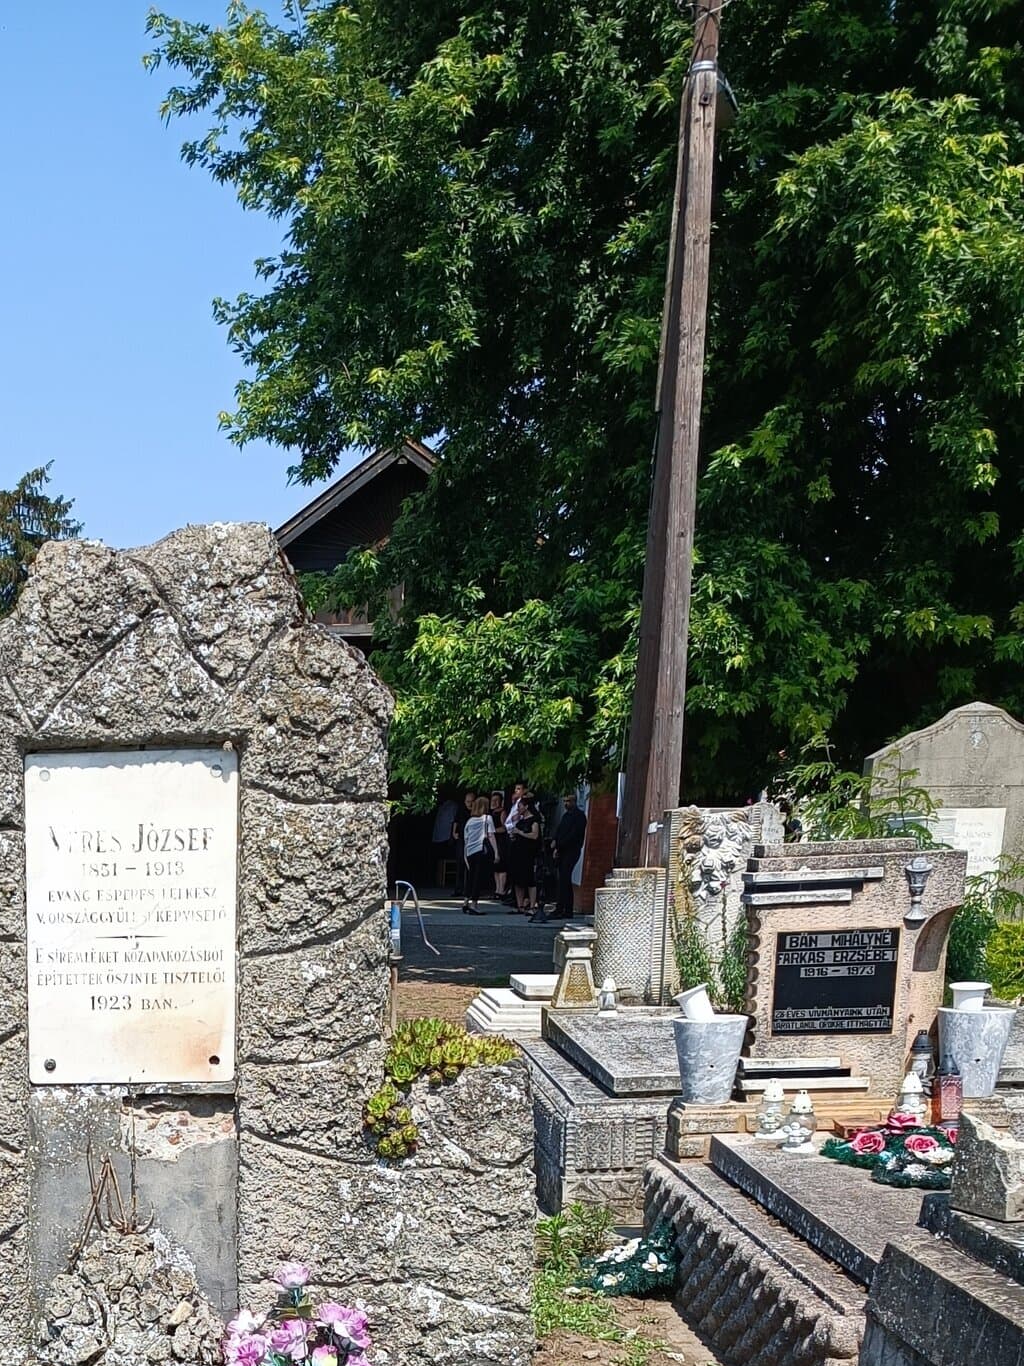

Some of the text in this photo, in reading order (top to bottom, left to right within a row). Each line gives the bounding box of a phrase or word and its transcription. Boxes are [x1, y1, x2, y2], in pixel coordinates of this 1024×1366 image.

[132, 822, 215, 853] JÓZSEF
[778, 951, 826, 964] FARKAS
[804, 967, 828, 976] 1916
[847, 966, 874, 975] 1973
[90, 995, 132, 1011] 1923
